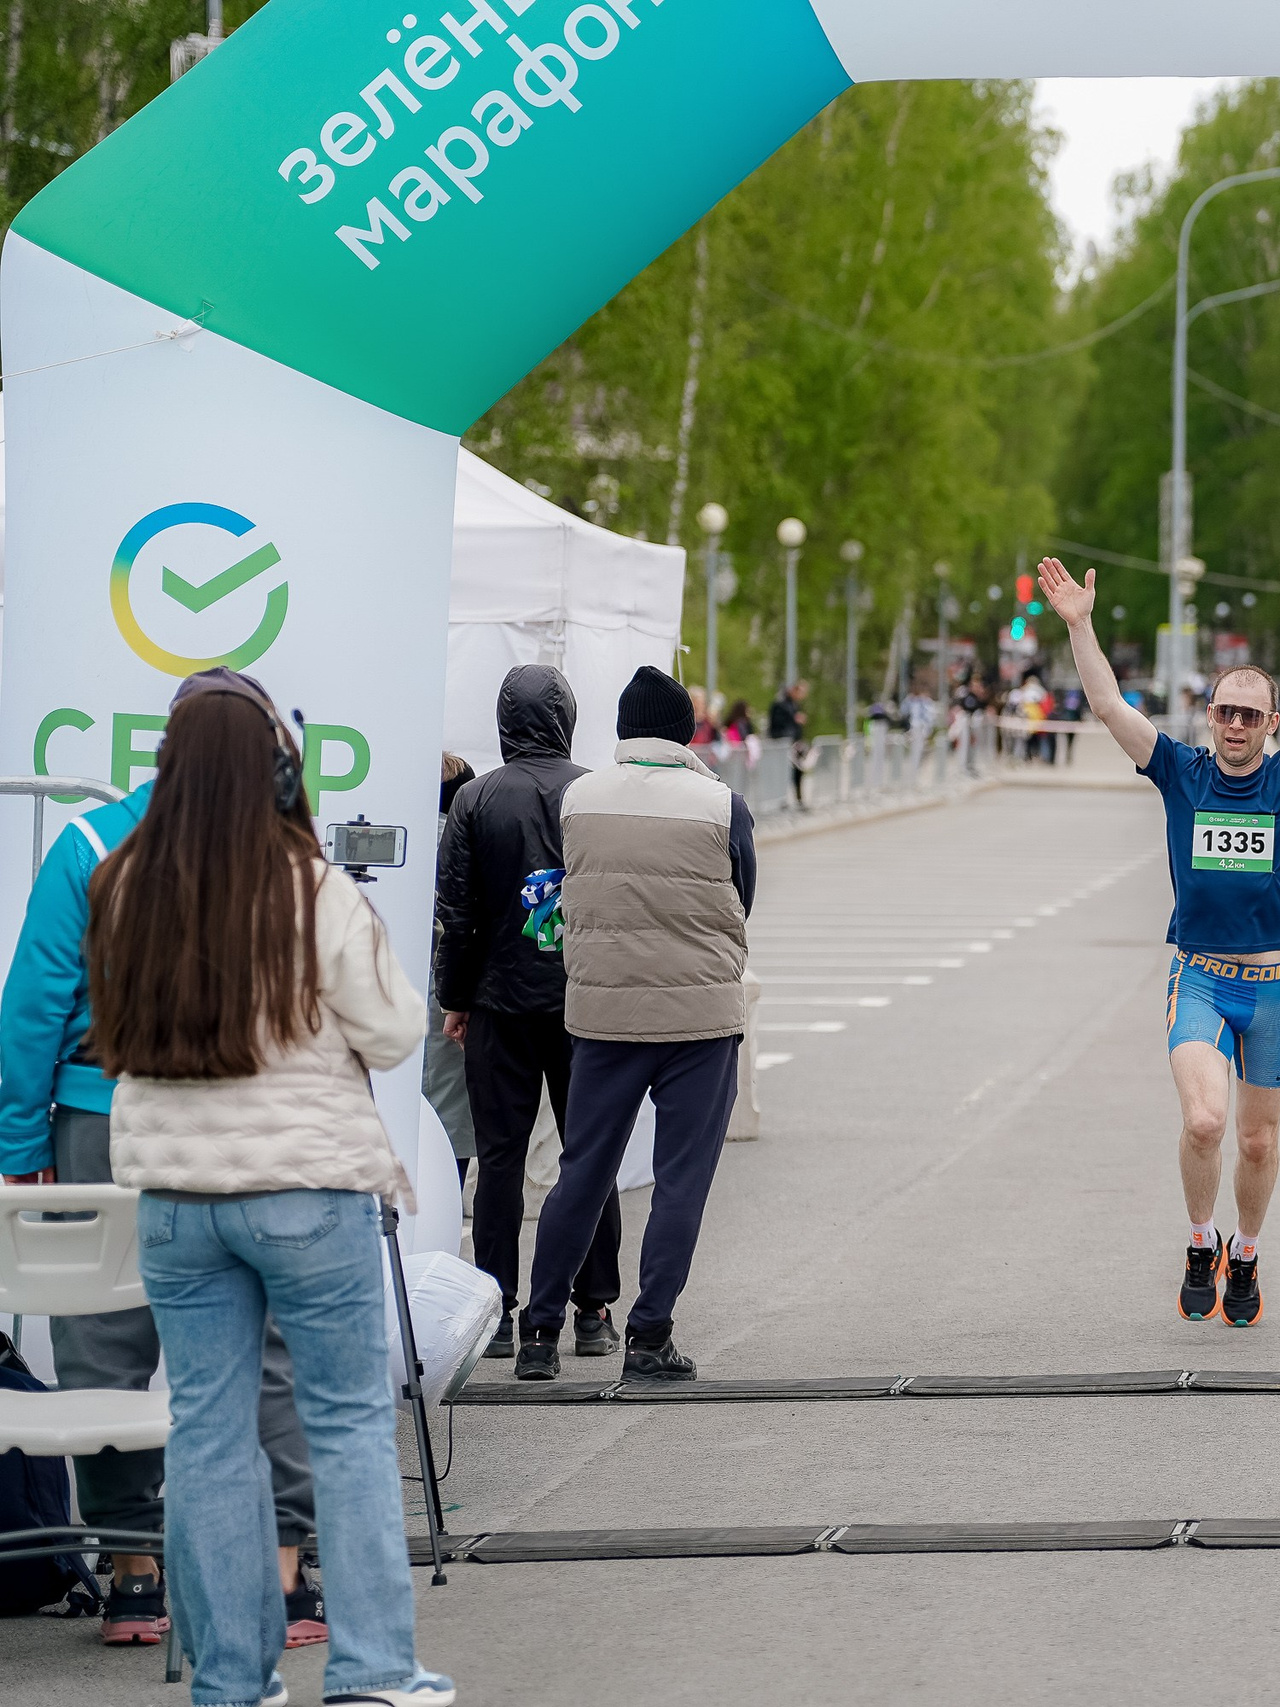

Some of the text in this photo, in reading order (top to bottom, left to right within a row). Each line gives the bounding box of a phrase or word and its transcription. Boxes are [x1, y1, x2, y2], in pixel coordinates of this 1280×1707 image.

[278, 0, 536, 205] зелён
[33, 707, 371, 817] СР
[1202, 829, 1265, 854] 1335
[1188, 953, 1239, 978] PRO
